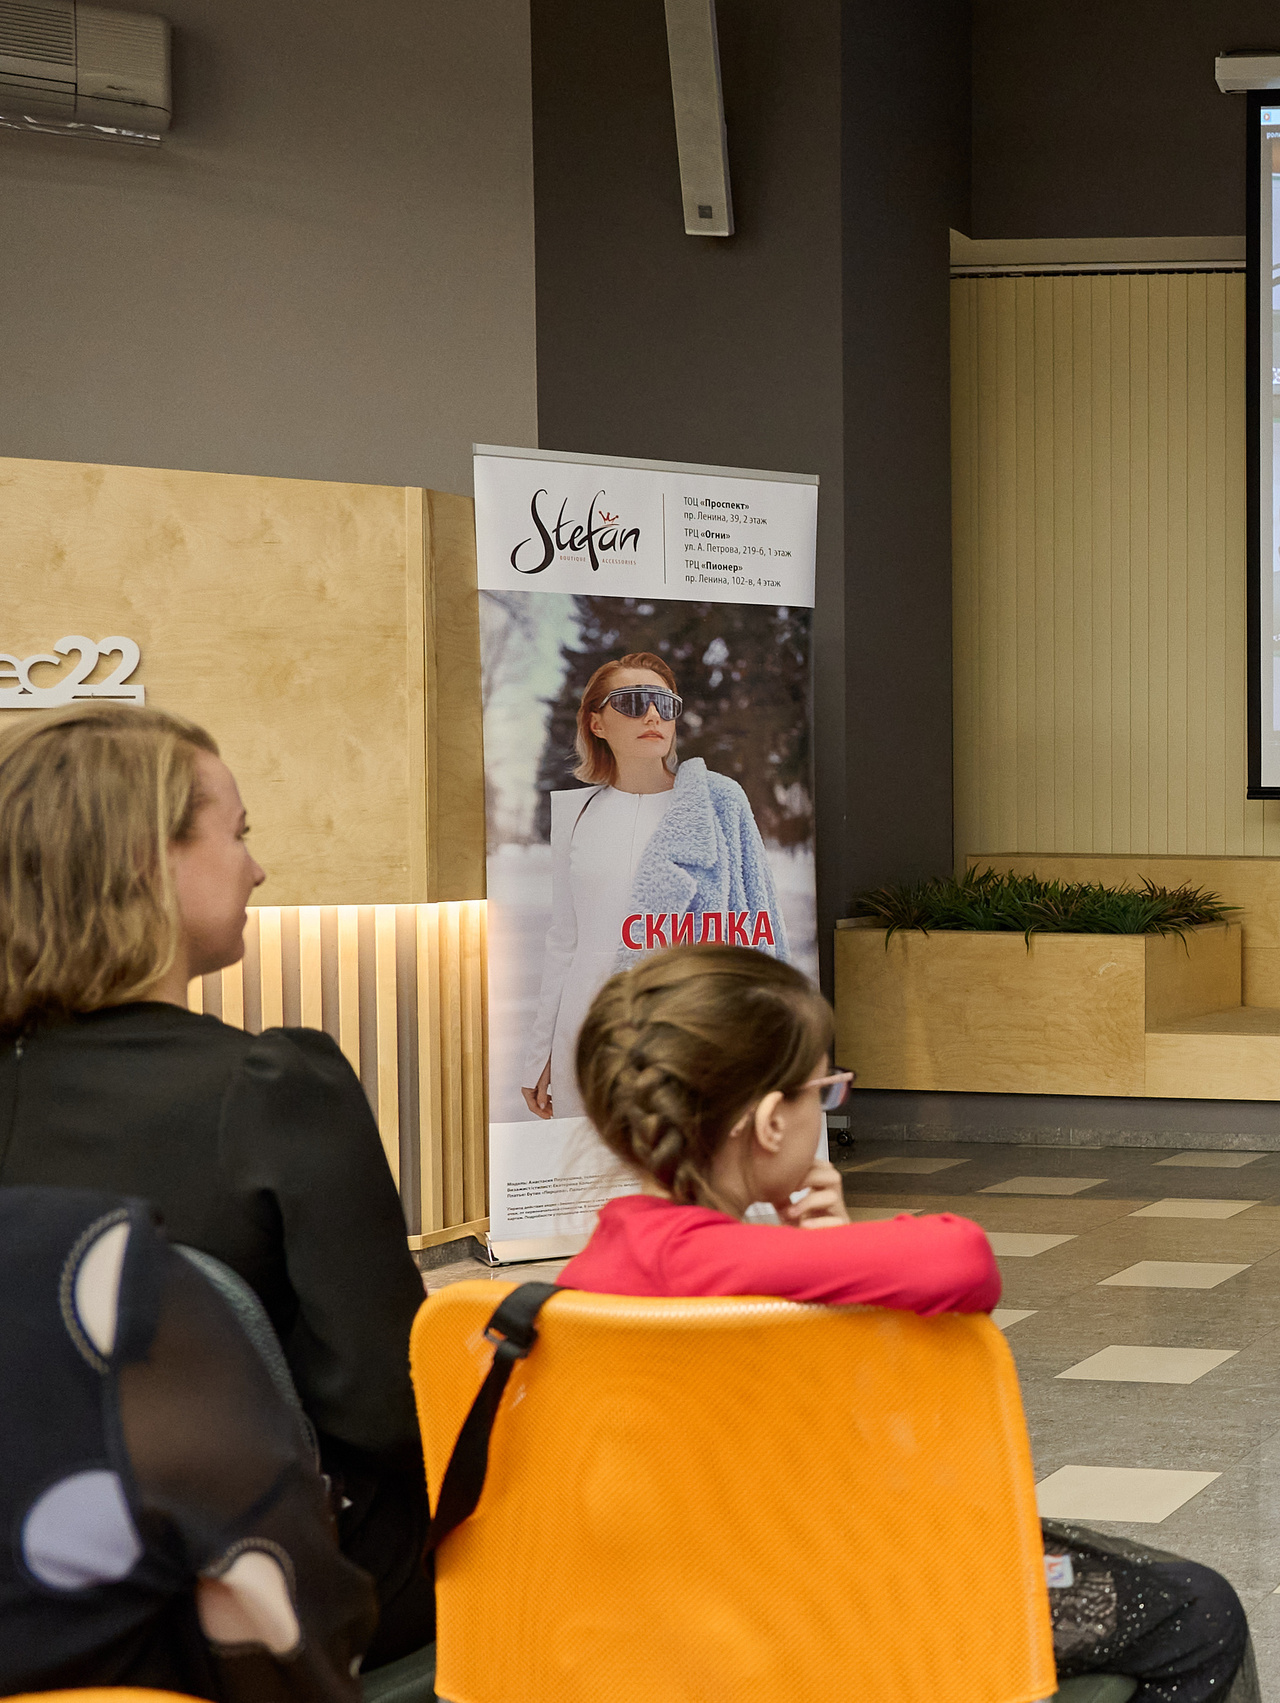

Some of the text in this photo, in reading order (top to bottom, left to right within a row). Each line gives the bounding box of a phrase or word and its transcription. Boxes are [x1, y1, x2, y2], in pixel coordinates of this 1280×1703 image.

[683, 496, 750, 510] ТОЦ «Проспект»
[683, 511, 767, 525] пр. Ленина, 39, 2 этаж
[510, 488, 641, 575] Stefan
[684, 527, 730, 540] ТРЦ «Огни»
[684, 542, 695, 552] ул.
[706, 542, 741, 556] Петрова,
[773, 549, 792, 557] этаж
[559, 555, 637, 566] BOUTIQUE ACCESSORIES
[684, 559, 743, 573] ТРЦ «Пионер»
[685, 574, 697, 584] пр.
[698, 573, 730, 586] Ленина,
[756, 577, 762, 586] 4
[763, 579, 782, 587] этаж
[621, 910, 775, 951] СКИДКА
